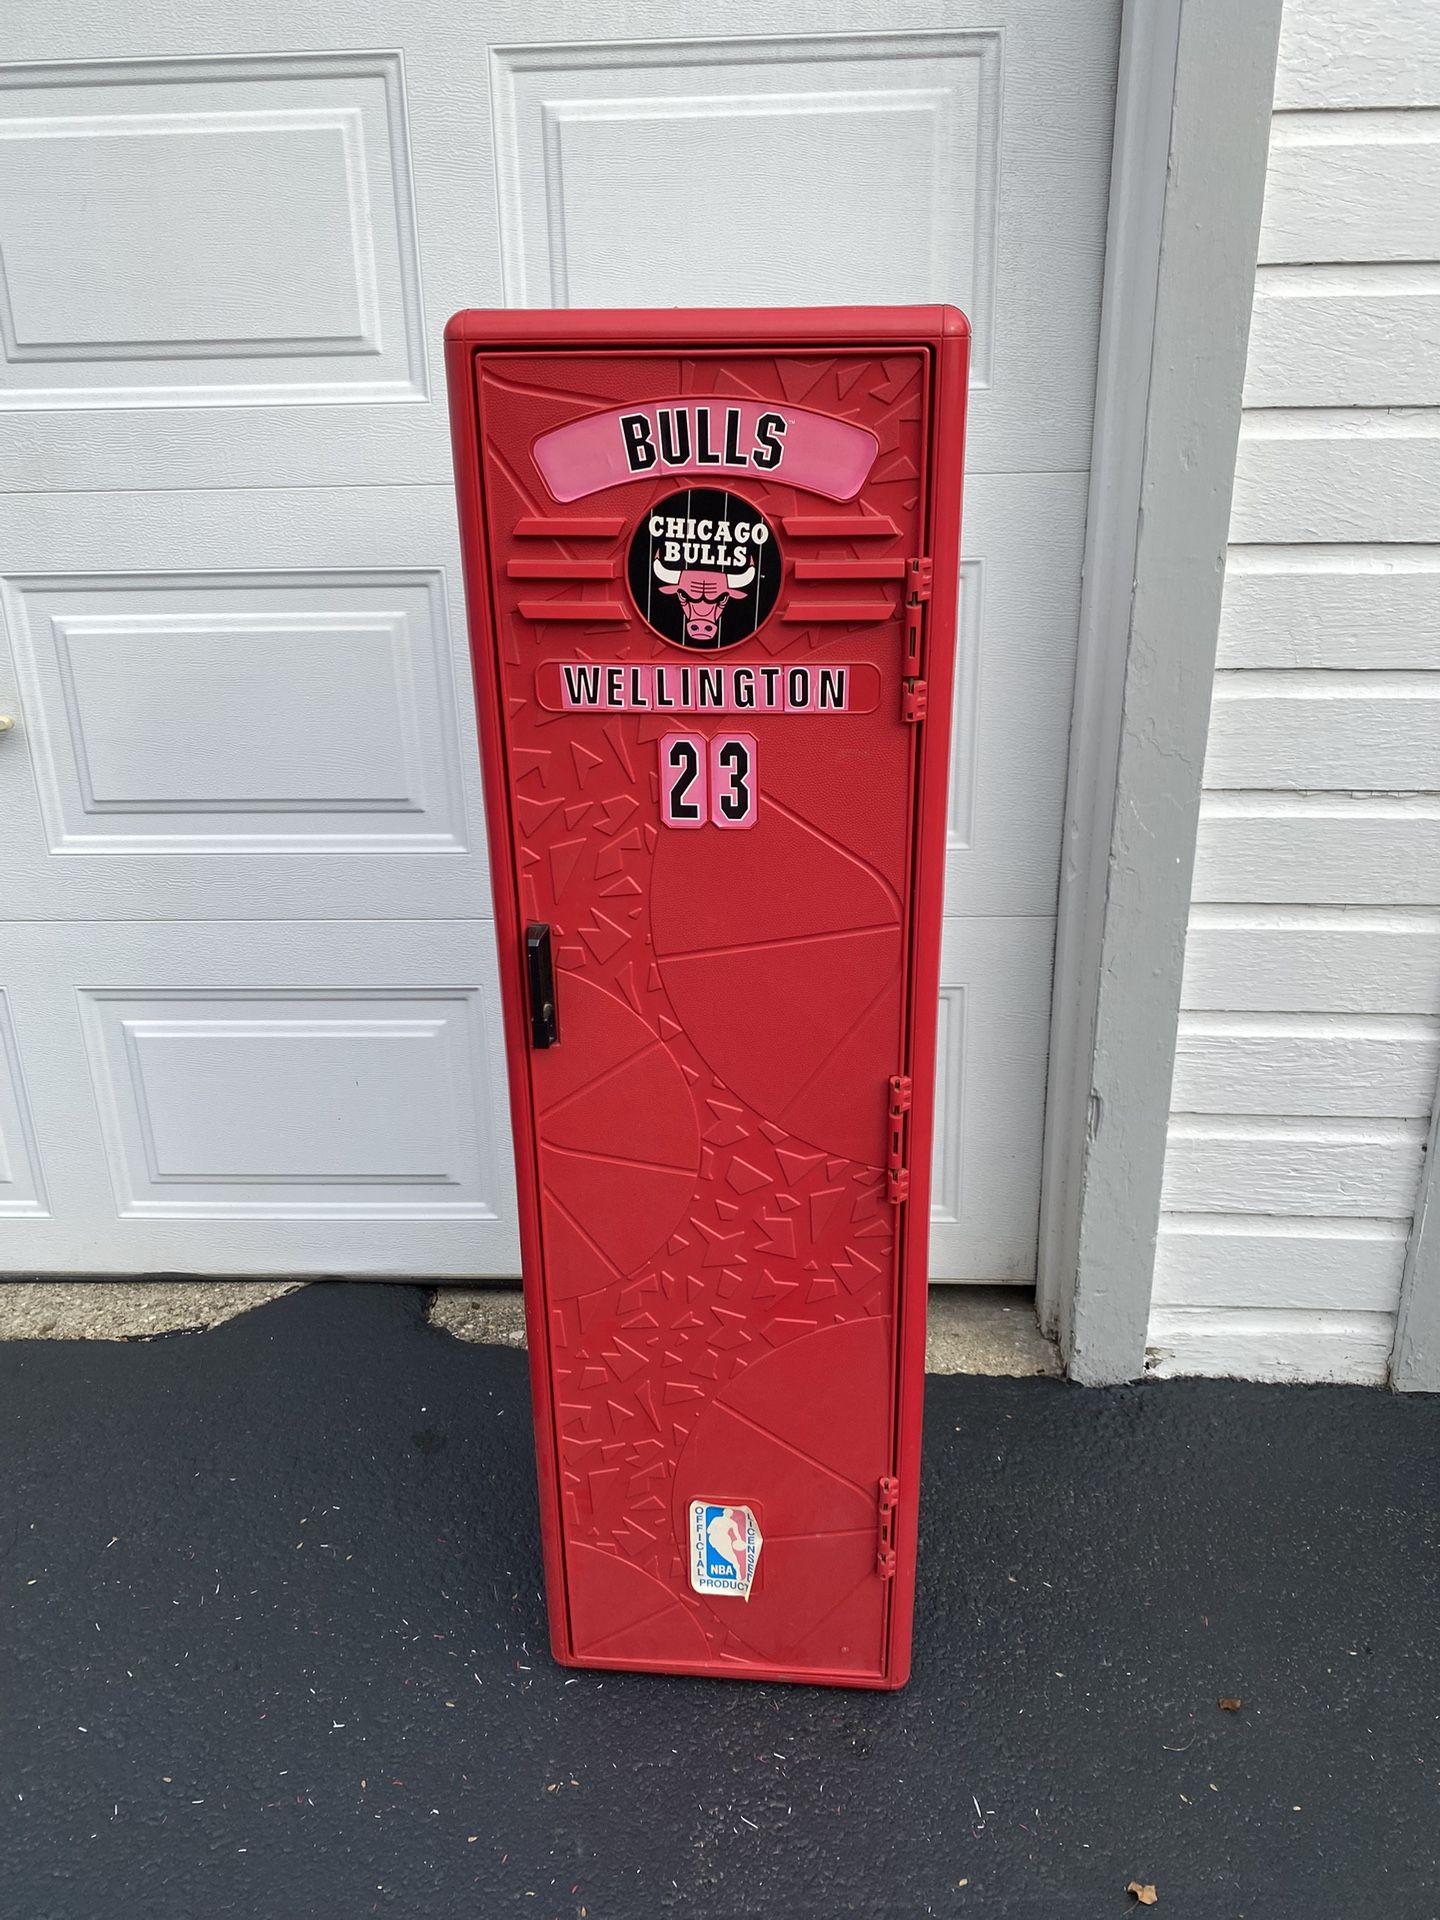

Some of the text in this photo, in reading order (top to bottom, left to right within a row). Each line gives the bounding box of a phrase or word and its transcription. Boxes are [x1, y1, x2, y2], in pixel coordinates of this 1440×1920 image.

[619, 407, 788, 472] BULLS
[648, 515, 769, 545] CHICAGO
[664, 541, 747, 567] BULLS
[563, 665, 846, 709] WELLINGTON
[668, 739, 751, 820] 23
[695, 1507, 704, 1576] OFFICIAL
[710, 1565, 733, 1575] NBA
